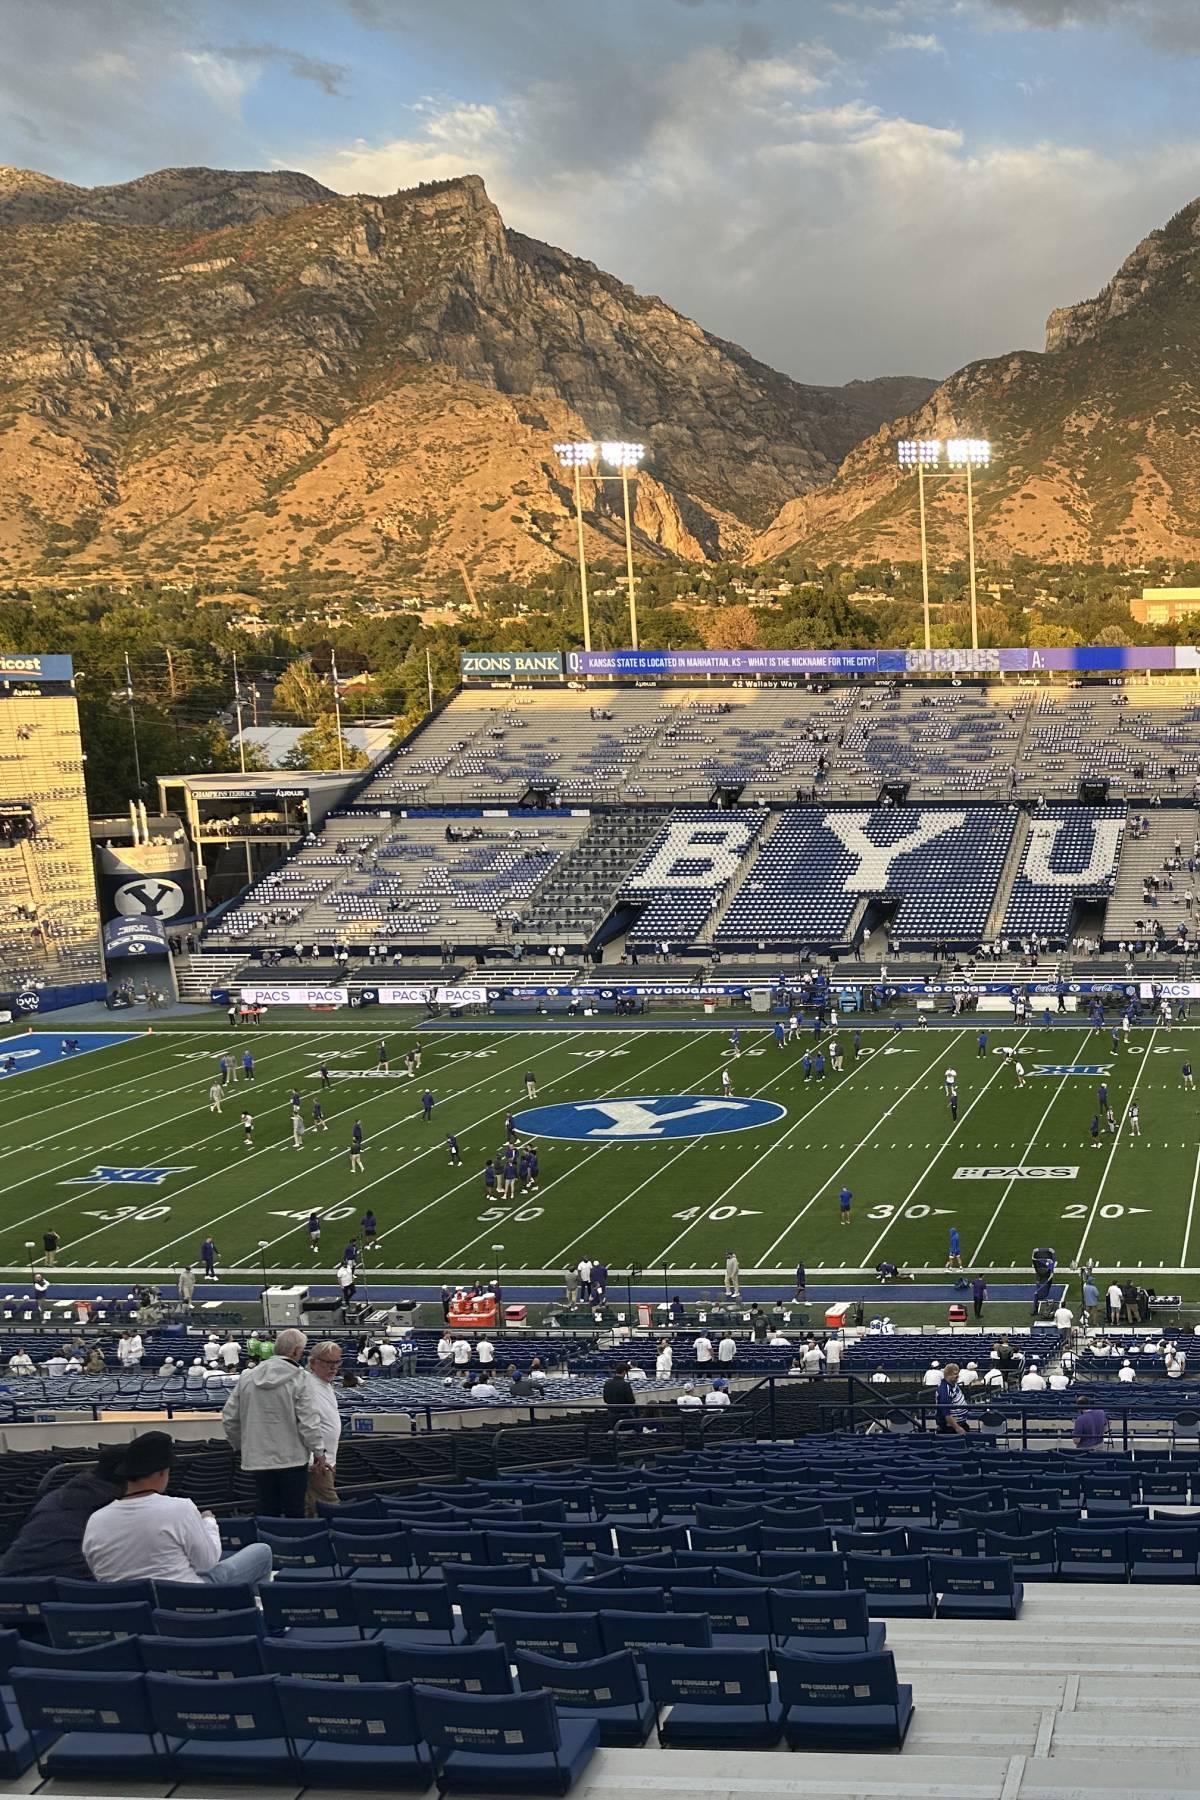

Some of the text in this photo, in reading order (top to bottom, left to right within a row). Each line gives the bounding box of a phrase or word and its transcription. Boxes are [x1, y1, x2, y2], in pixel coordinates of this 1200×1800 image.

[0, 656, 41, 670] icost
[463, 657, 560, 670] ZIONS BANK
[569, 652, 584, 672] Q:
[588, 659, 616, 669] KANSAS
[617, 659, 638, 668] STATE
[639, 659, 646, 668] IS
[647, 658, 677, 668] LOCATED
[678, 658, 686, 668] IN
[748, 657, 768, 667] WHAT
[769, 657, 776, 667] IS
[778, 657, 790, 667] THE
[791, 657, 827, 667] NICKNAME
[828, 657, 841, 667] FOR
[843, 657, 855, 667] THE
[856, 656, 876, 667] CITY?
[1031, 651, 1045, 669] A:
[745, 681, 779, 689] Wallaby
[780, 681, 798, 689] Way
[628, 811, 1127, 893] BYU
[124, 884, 174, 916] Y
[16, 996, 39, 1006] byu
[256, 991, 342, 1001] PACS PACS
[393, 990, 480, 1001] PACS PACS
[983, 1169, 1072, 1178] PACS
[100, 1206, 171, 1221] 30
[295, 1206, 357, 1221] 40
[477, 1206, 546, 1222] 50
[672, 1205, 738, 1221] 40
[868, 1204, 931, 1220] 30
[1062, 1204, 1125, 1220] 20
[401, 1343, 413, 1352] 23
